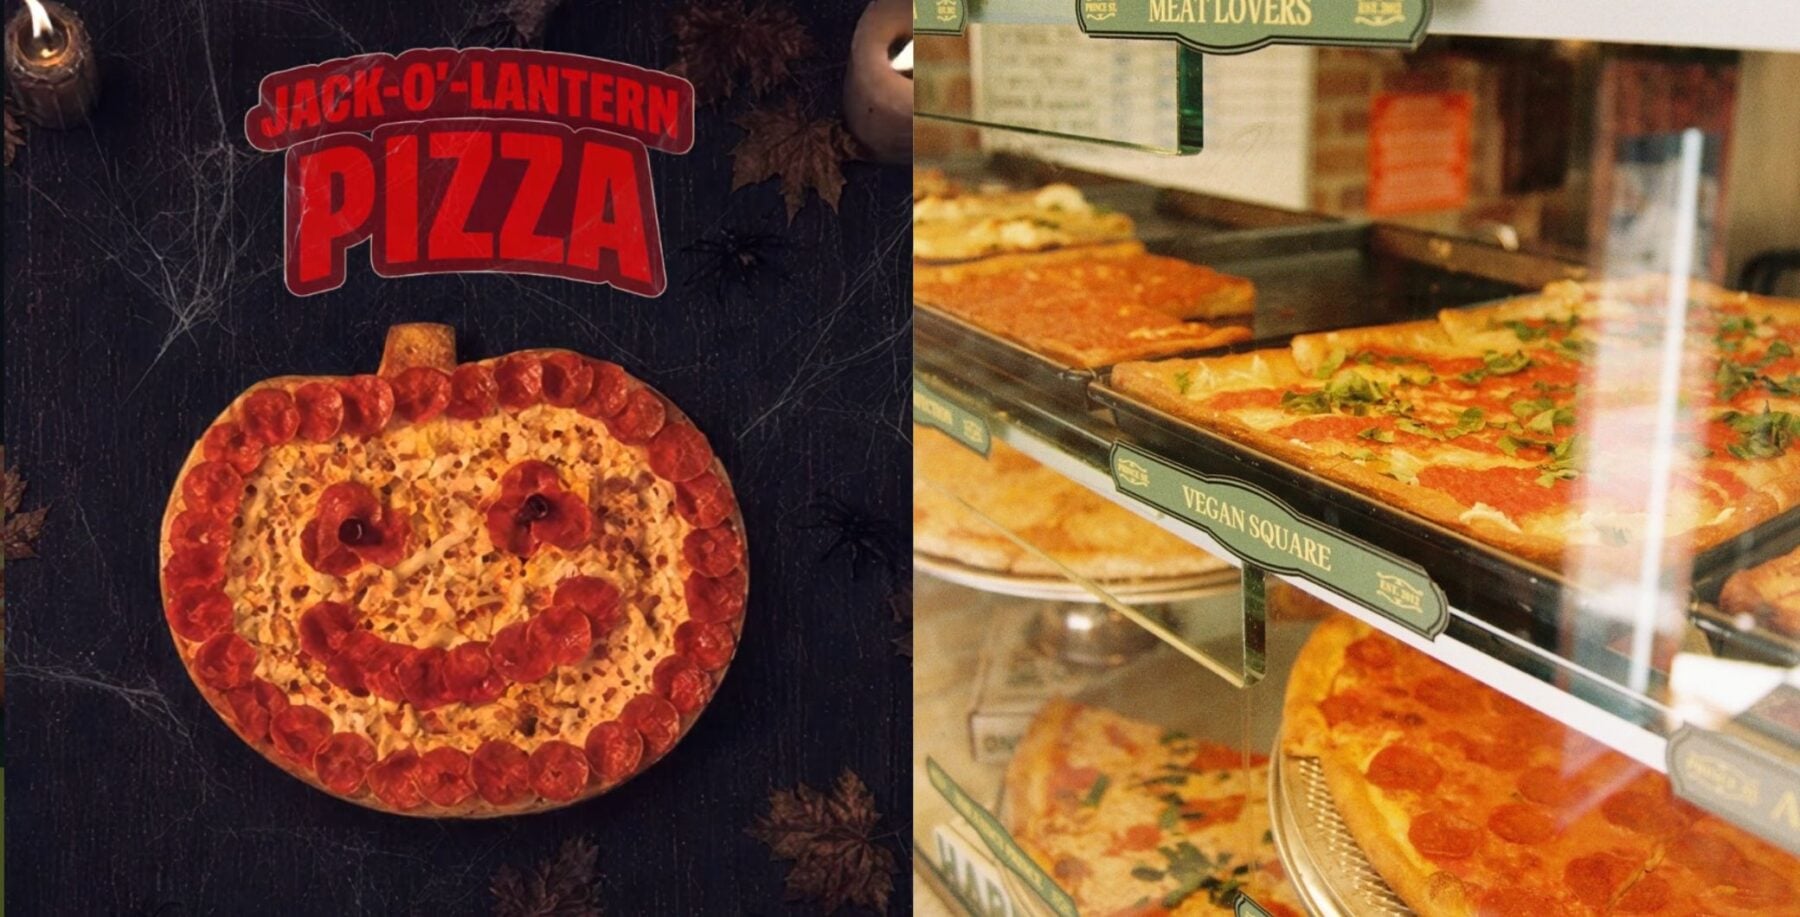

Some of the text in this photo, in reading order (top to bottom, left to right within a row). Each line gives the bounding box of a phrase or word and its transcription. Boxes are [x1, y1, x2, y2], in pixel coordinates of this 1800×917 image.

[1148, 0, 1313, 26] MEAT LOVERS
[260, 61, 679, 139] JACK-O'-LANTERN
[300, 131, 653, 283] PIZZA
[1182, 484, 1332, 572] VEGAN SQUARE
